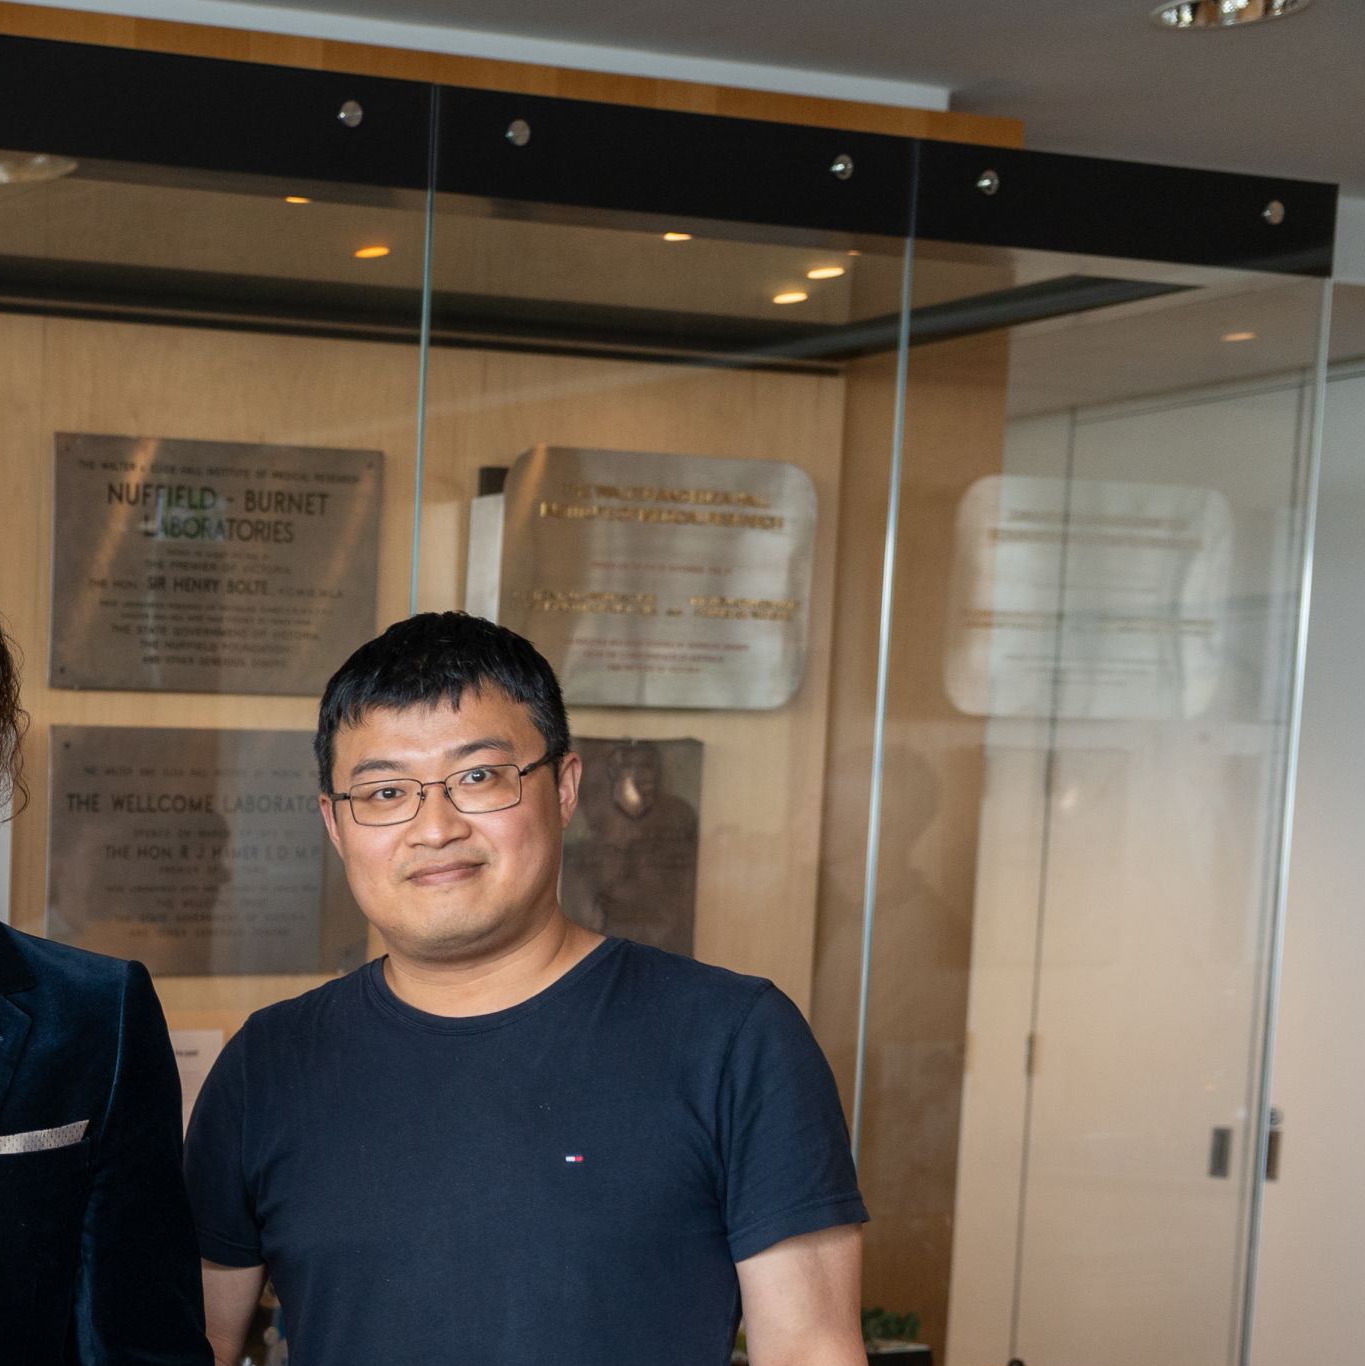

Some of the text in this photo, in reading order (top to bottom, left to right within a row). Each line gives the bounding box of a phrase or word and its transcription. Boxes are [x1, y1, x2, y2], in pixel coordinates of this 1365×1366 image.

[107, 482, 330, 516] NUFFIELD BURNET
[143, 515, 294, 544] LABORATORIES
[147, 576, 166, 592] SIR
[173, 577, 221, 594] HENRY
[67, 793, 214, 813] THE WELLCOME
